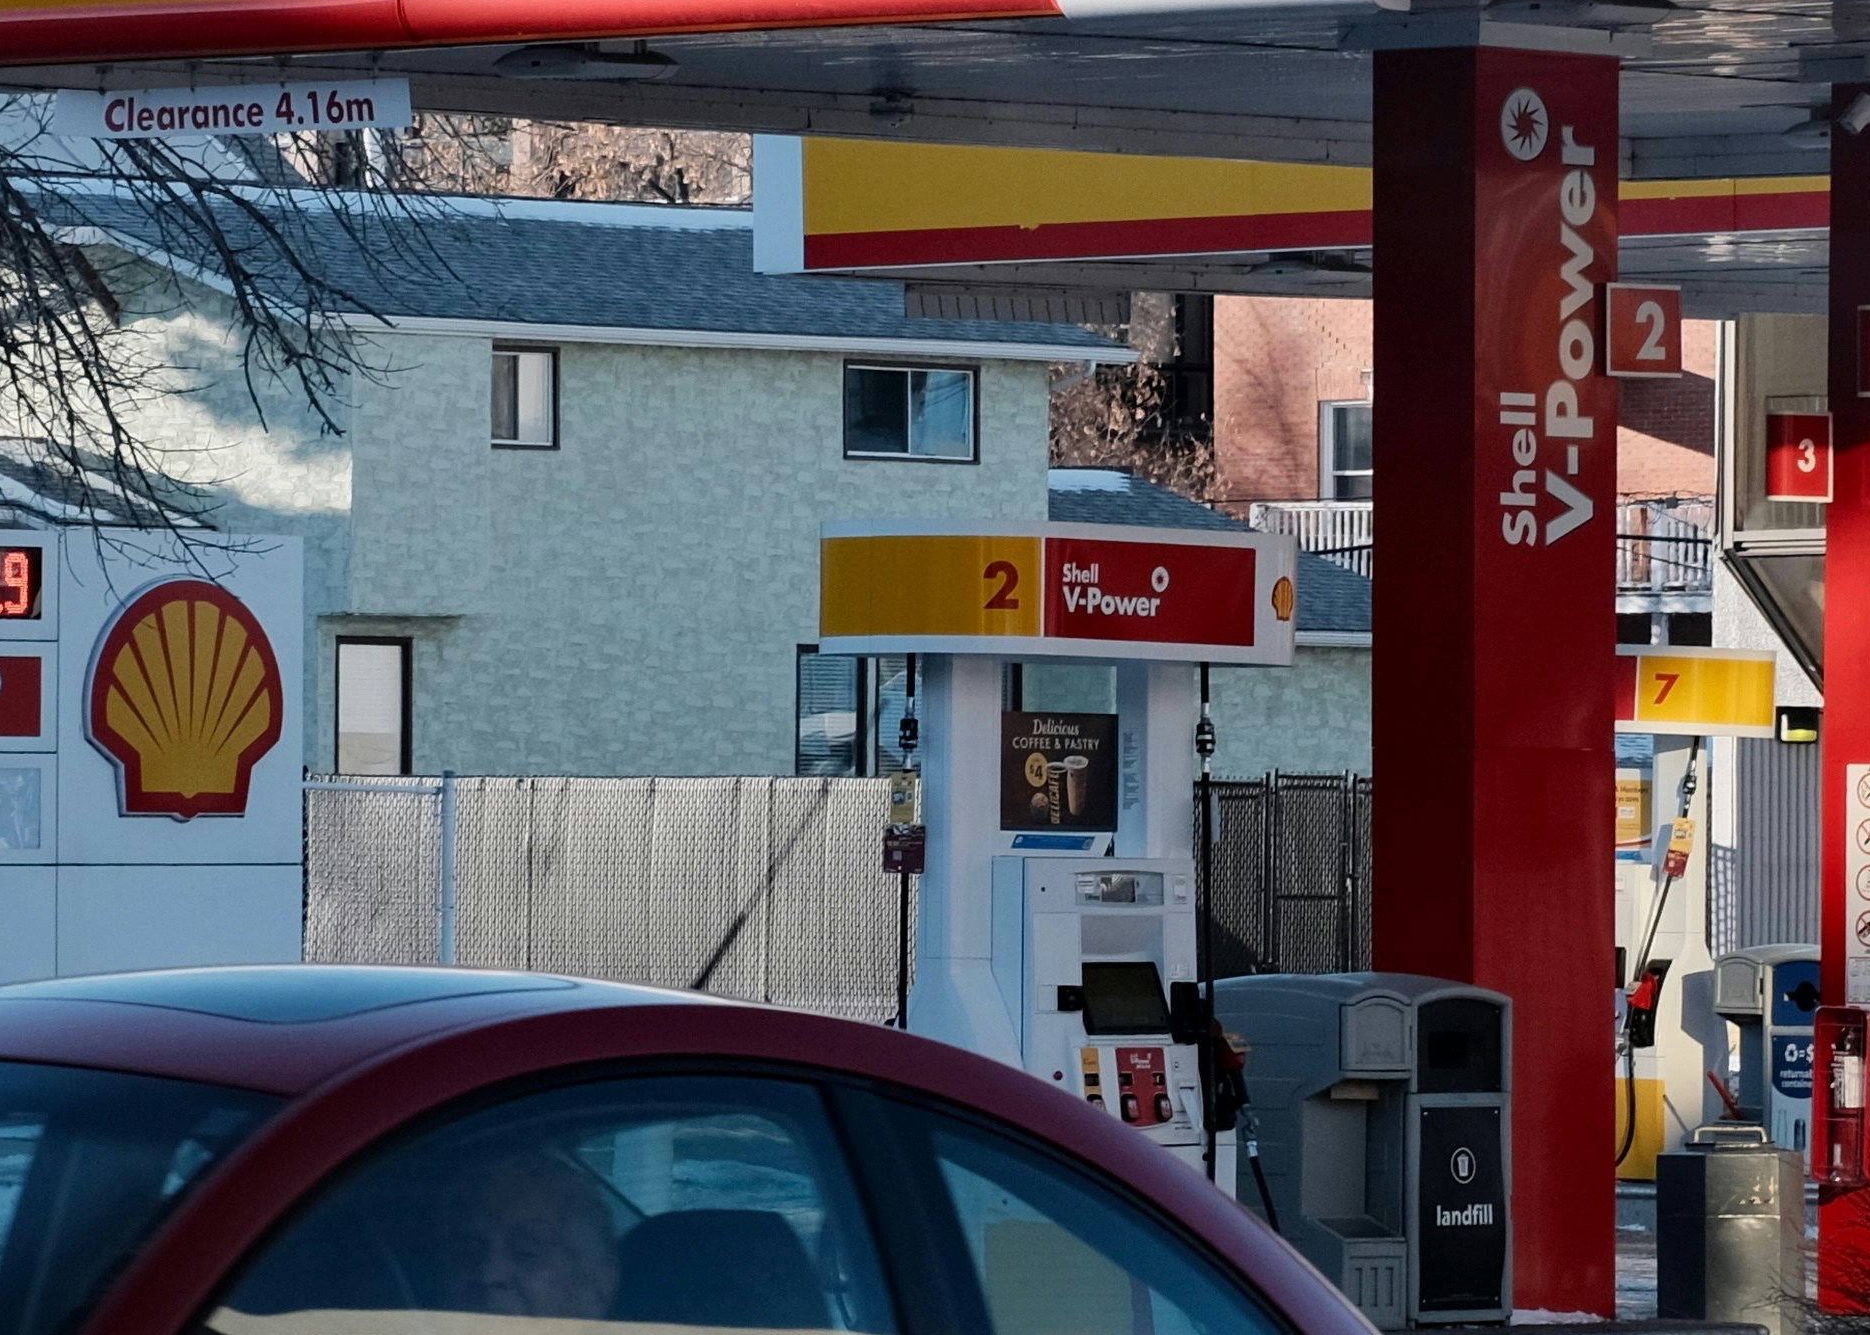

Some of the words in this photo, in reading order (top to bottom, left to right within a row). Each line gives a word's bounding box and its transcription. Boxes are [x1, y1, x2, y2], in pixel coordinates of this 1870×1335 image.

[104, 98, 264, 132] Clearance
[275, 90, 375, 126] 4.16m
[1544, 125, 1596, 548] V-Power
[1636, 301, 1666, 360] 2
[1500, 392, 1537, 547] Shell
[1797, 439, 1816, 474] 3
[983, 561, 1019, 609] 2
[1062, 563, 1099, 584] Shell
[1063, 587, 1160, 617] V-Power
[1653, 673, 1679, 704] 7
[1012, 737, 1051, 749] COFFEE
[1064, 738, 1100, 750] PASTRY
[1032, 719, 1080, 736] Delicious
[1436, 1203, 1494, 1227] landfill
